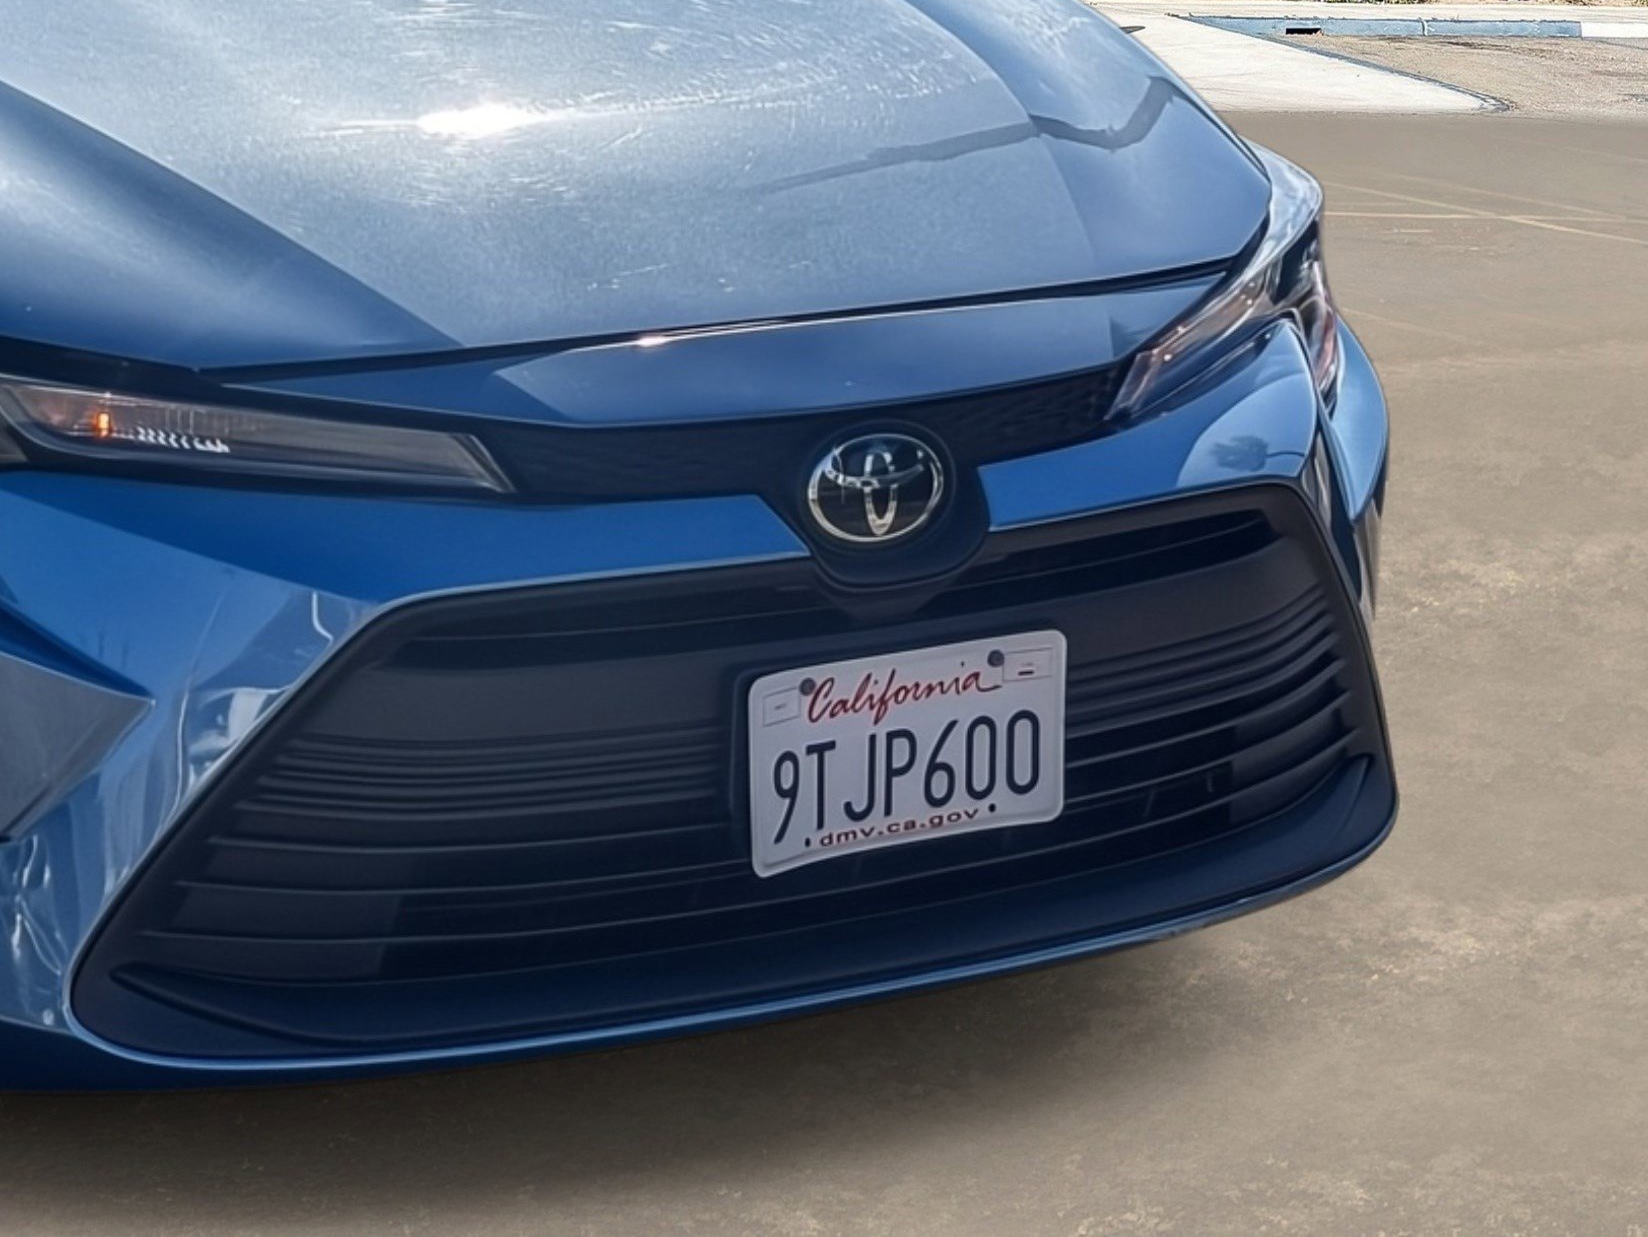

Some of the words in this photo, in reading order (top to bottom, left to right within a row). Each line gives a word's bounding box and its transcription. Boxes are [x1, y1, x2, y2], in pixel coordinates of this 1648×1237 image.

[807, 662, 1002, 726] California
[772, 709, 1041, 845] 9TJP600
[818, 806, 980, 848] dmv.ca.gov
